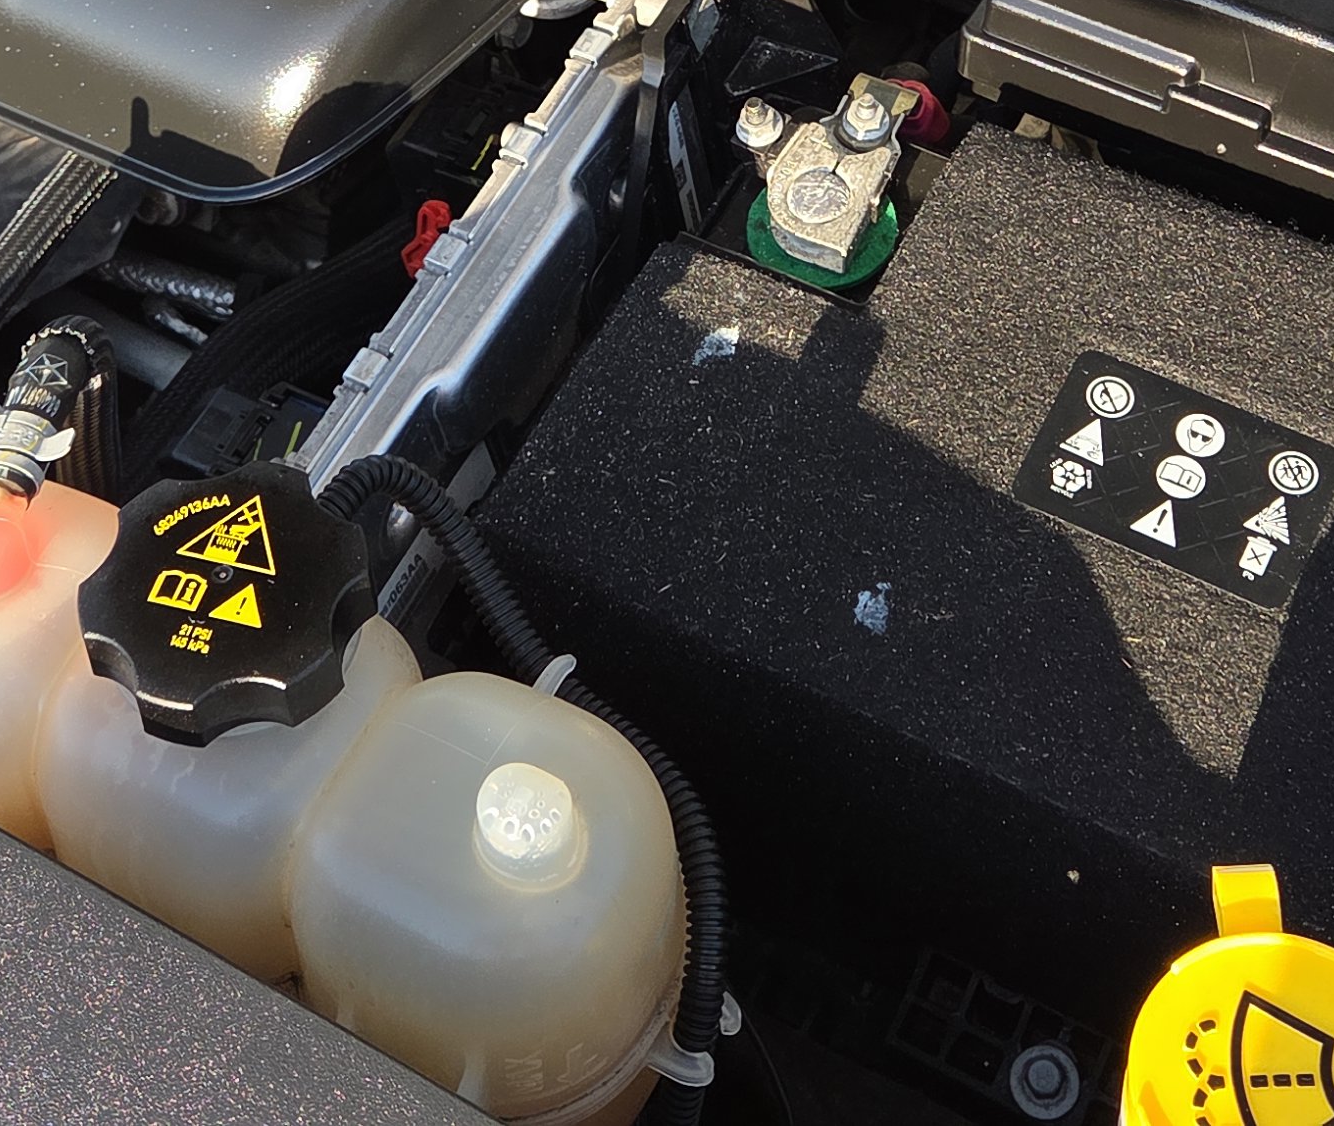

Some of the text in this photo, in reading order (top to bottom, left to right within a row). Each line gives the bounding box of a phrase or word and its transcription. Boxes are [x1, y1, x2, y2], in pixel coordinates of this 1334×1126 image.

[153, 493, 231, 537] 68249136AA
[178, 624, 213, 641] 21 PSI
[187, 639, 210, 655] kPa
